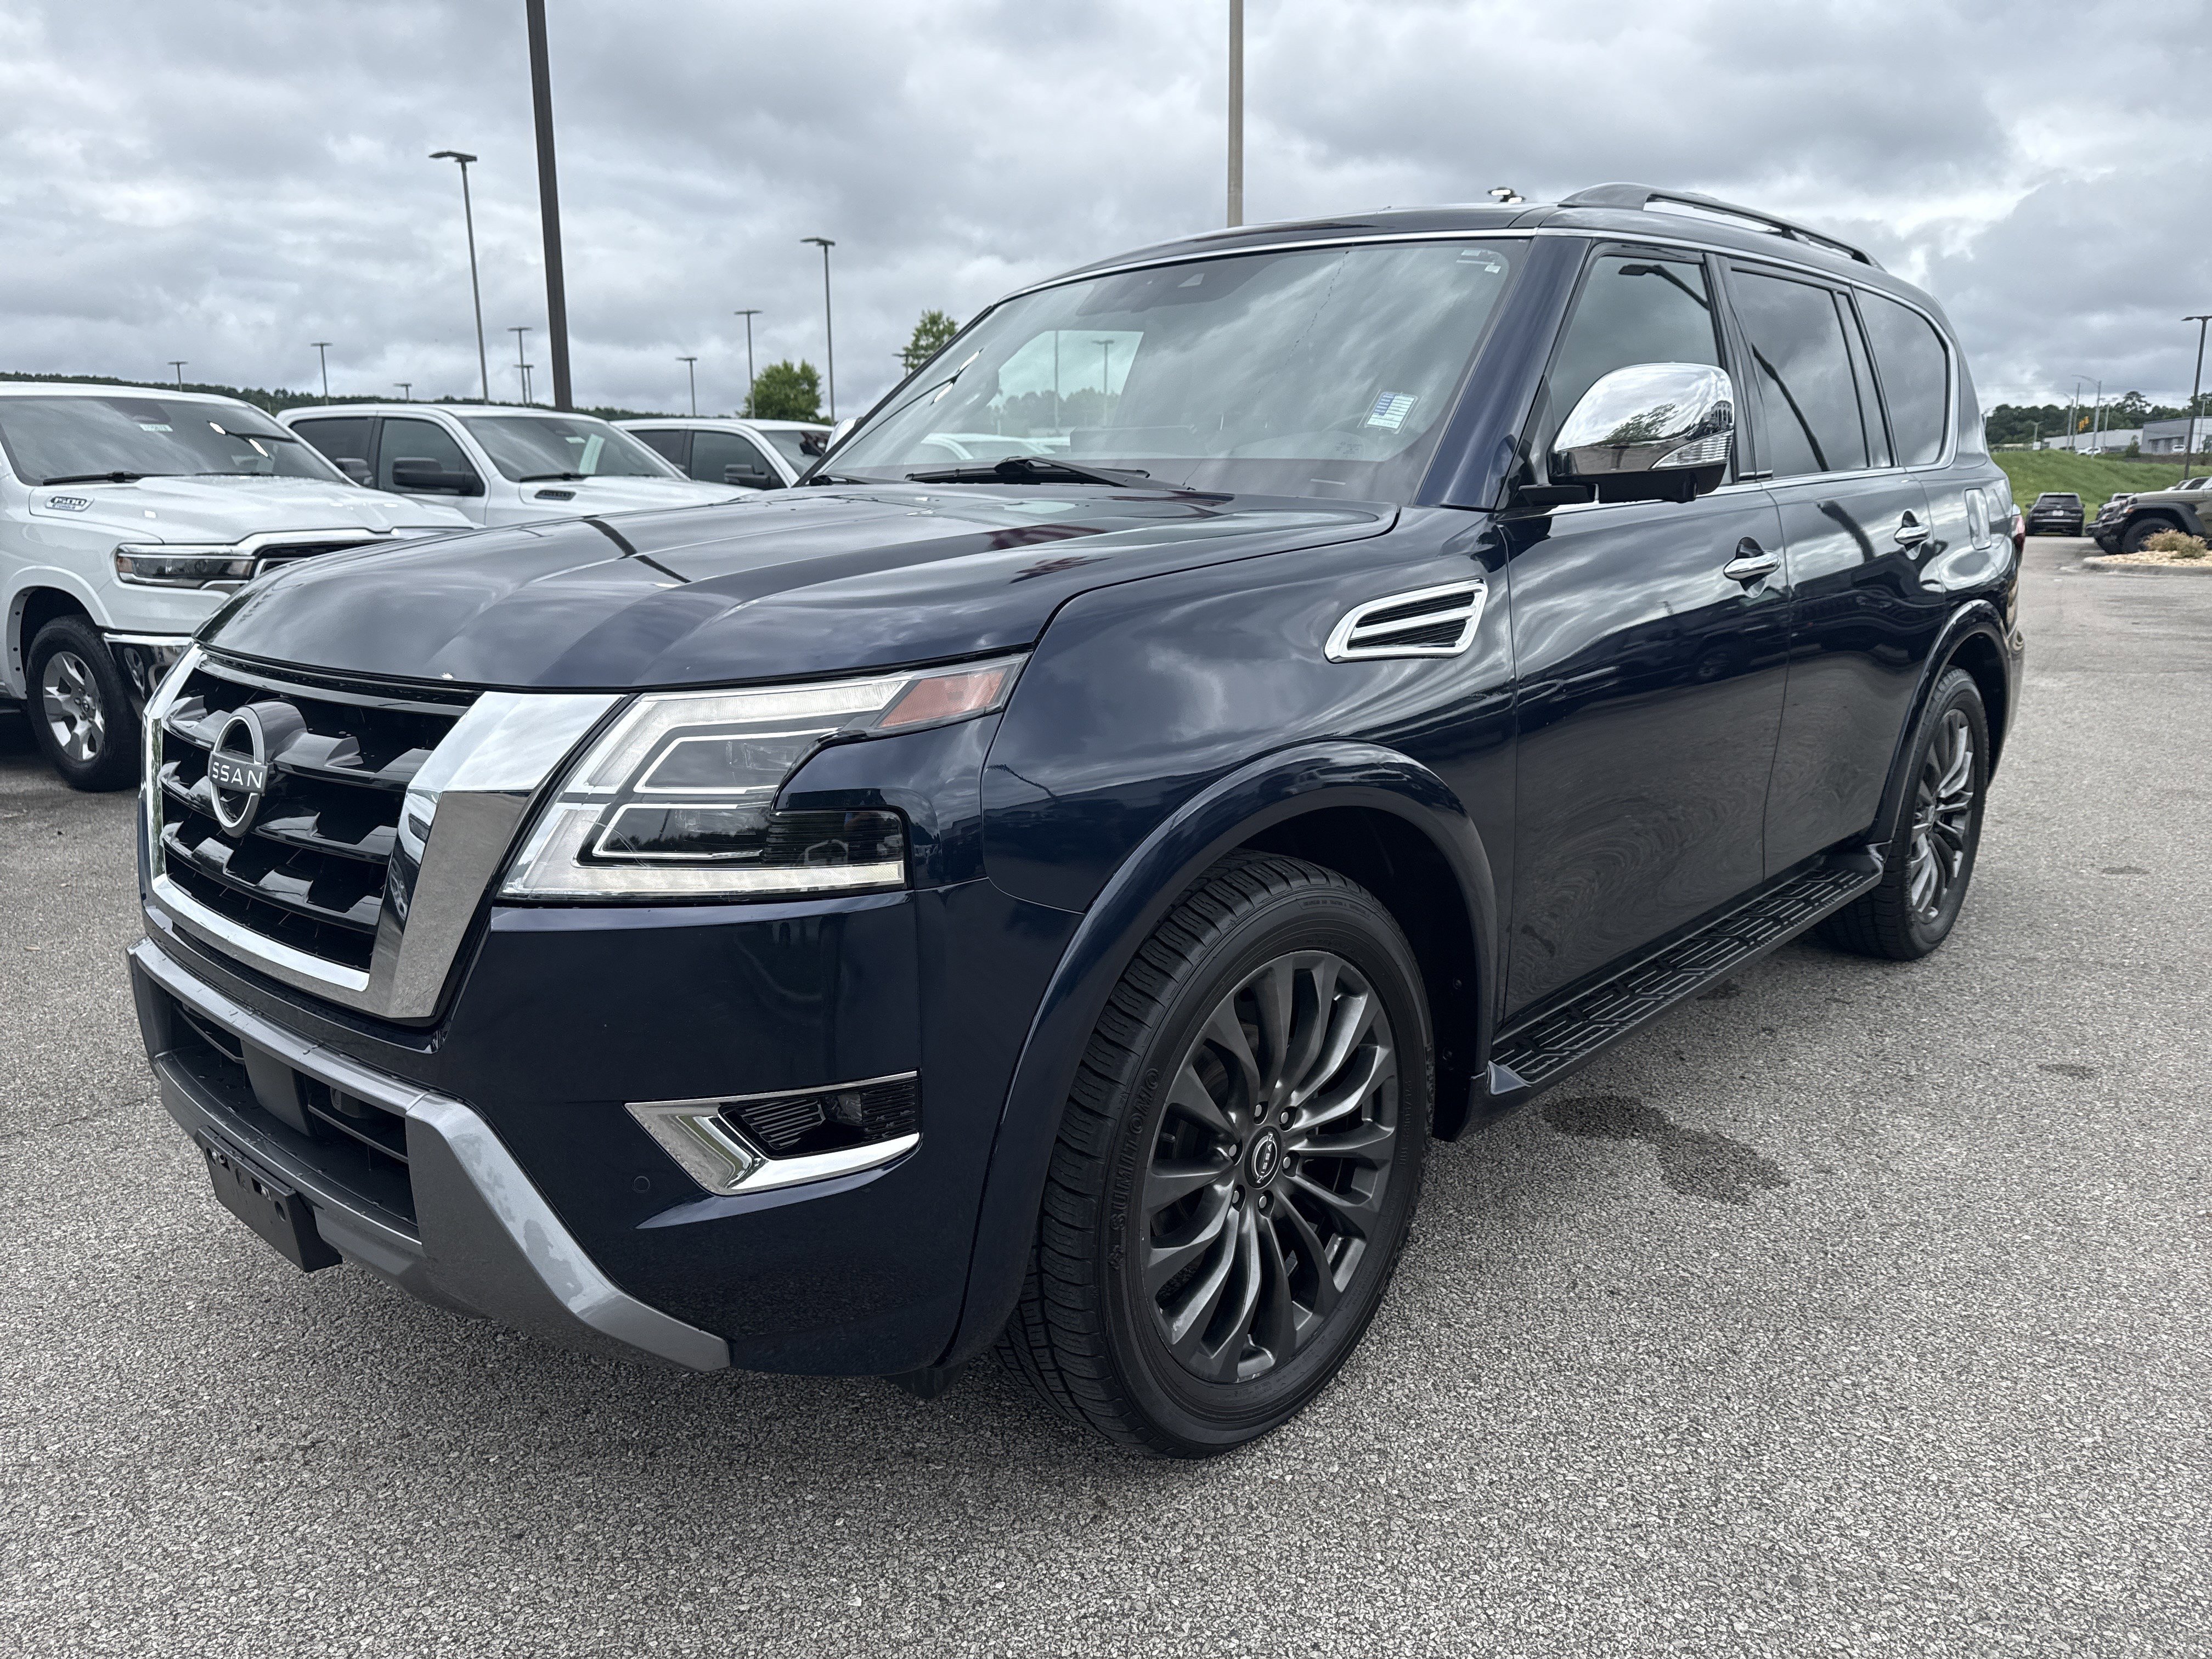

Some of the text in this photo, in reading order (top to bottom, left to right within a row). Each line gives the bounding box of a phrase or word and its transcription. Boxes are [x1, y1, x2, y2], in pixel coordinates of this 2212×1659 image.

[212, 761, 262, 788] SSAN
[1110, 1068, 1159, 1231] SUMITOMO
[1257, 1133, 1273, 1183] NISSAN
